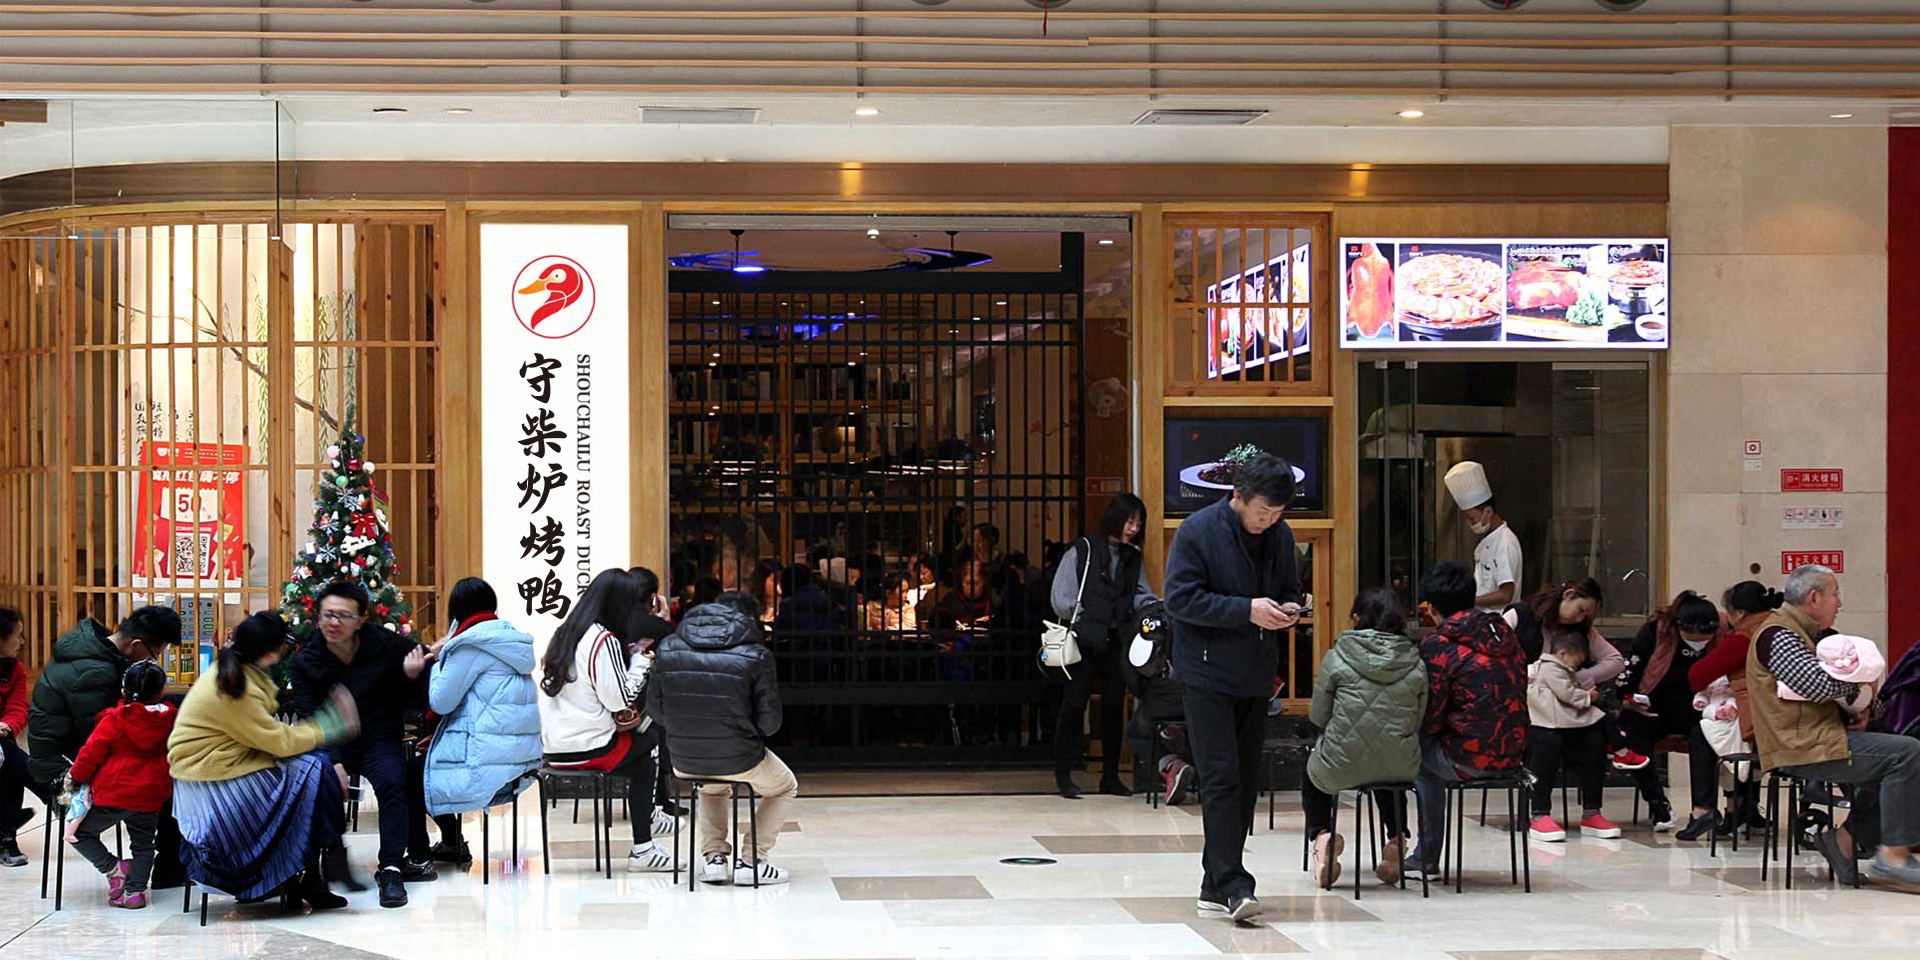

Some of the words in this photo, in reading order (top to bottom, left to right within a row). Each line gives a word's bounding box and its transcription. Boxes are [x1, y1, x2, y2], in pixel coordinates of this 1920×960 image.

[576, 354, 591, 472] SHOUCHAILU
[516, 352, 572, 620] 守柴炉烤鸭
[576, 480, 591, 539] ROAST
[576, 545, 591, 596] DUCK
